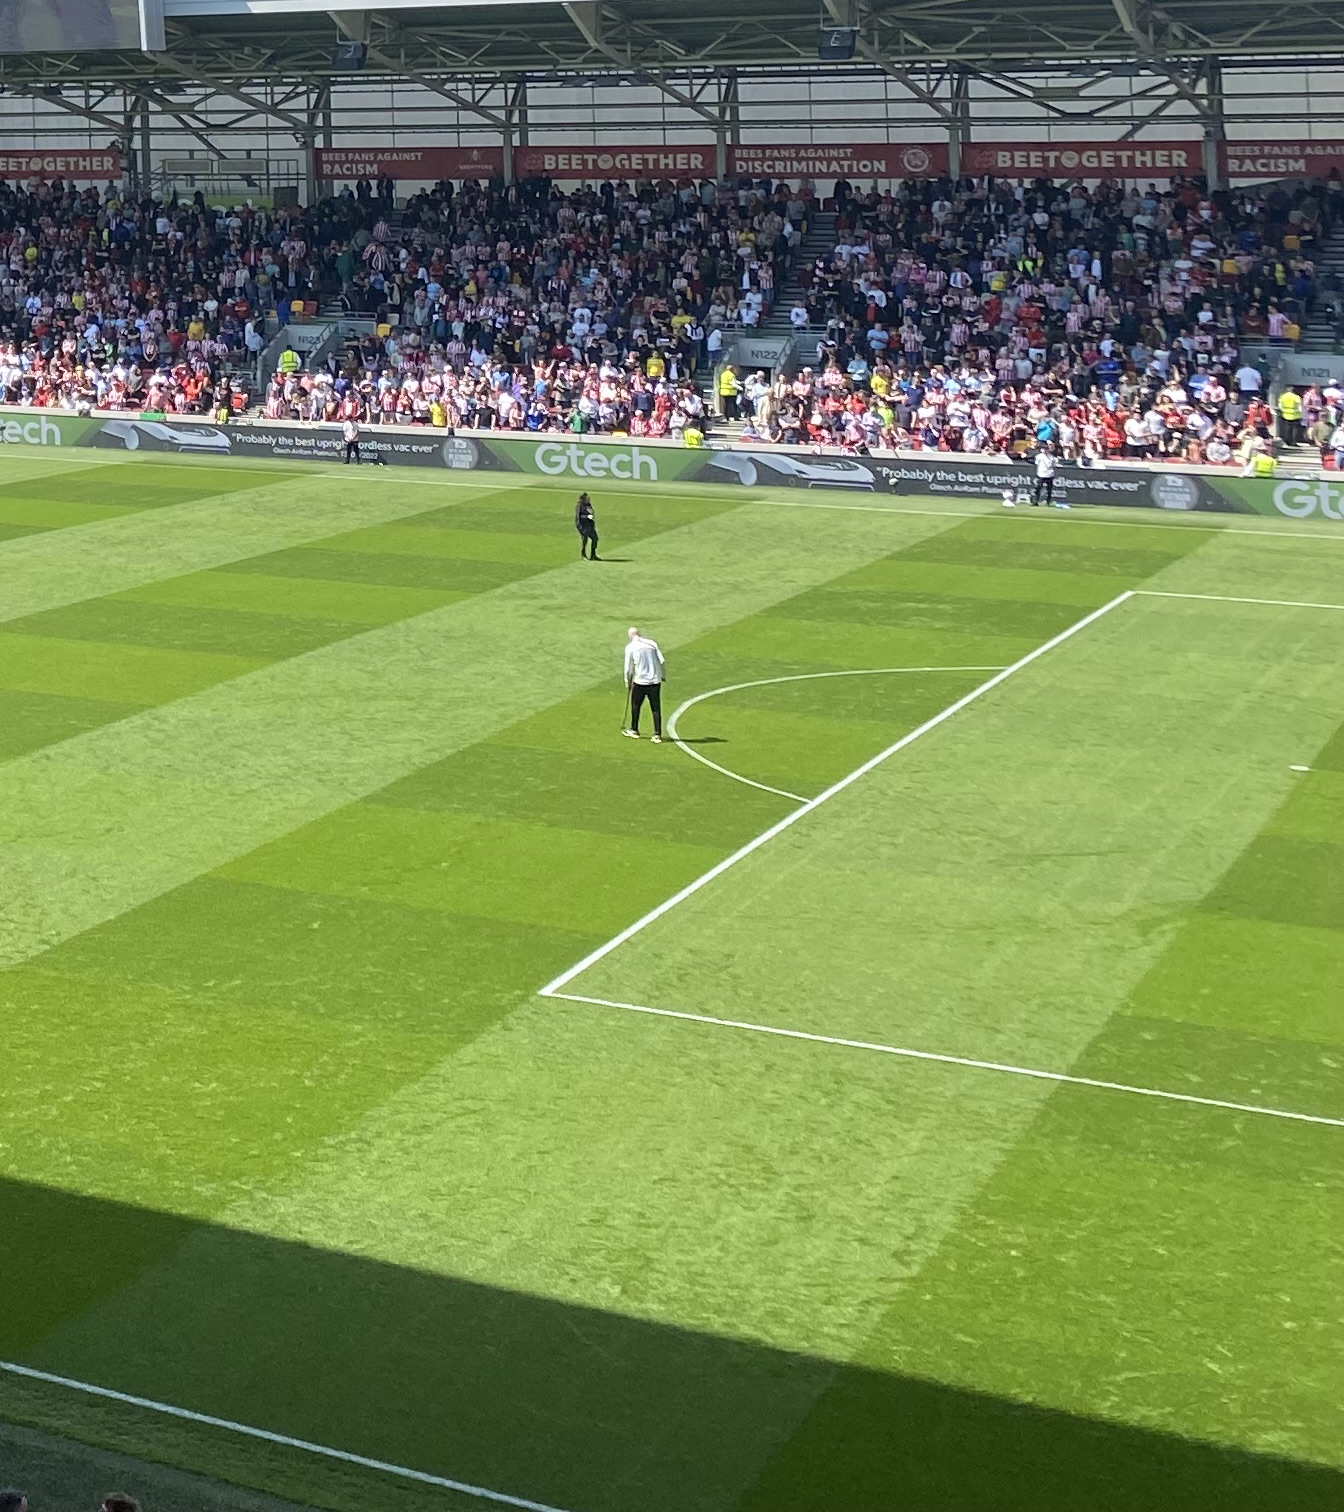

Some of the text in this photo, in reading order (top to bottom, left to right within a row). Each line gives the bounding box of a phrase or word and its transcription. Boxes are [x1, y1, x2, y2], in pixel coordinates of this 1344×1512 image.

[322, 152, 423, 161] BEES FANS AGAINST
[735, 148, 853, 158] BEES FANS AGAINST
[1263, 146, 1300, 155] FANS
[543, 153, 704, 170] BEETOGETHER
[997, 150, 1187, 168] BEETOGETHER
[1227, 158, 1306, 172] RACISM
[322, 163, 379, 175] RACISM
[735, 160, 886, 173] DISCRIMINATION
[751, 349, 779, 360] N122
[1301, 367, 1331, 378] N121
[278, 436, 294, 446] the
[295, 436, 316, 447] best
[357, 440, 392, 451] ordless
[393, 443, 411, 452] vac
[534, 442, 658, 481] Gtech
[936, 470, 957, 481] the
[957, 471, 985, 483] best
[986, 473, 1032, 488] upright
[1086, 480, 1110, 490] vac
[1272, 480, 1344, 520] Gt
